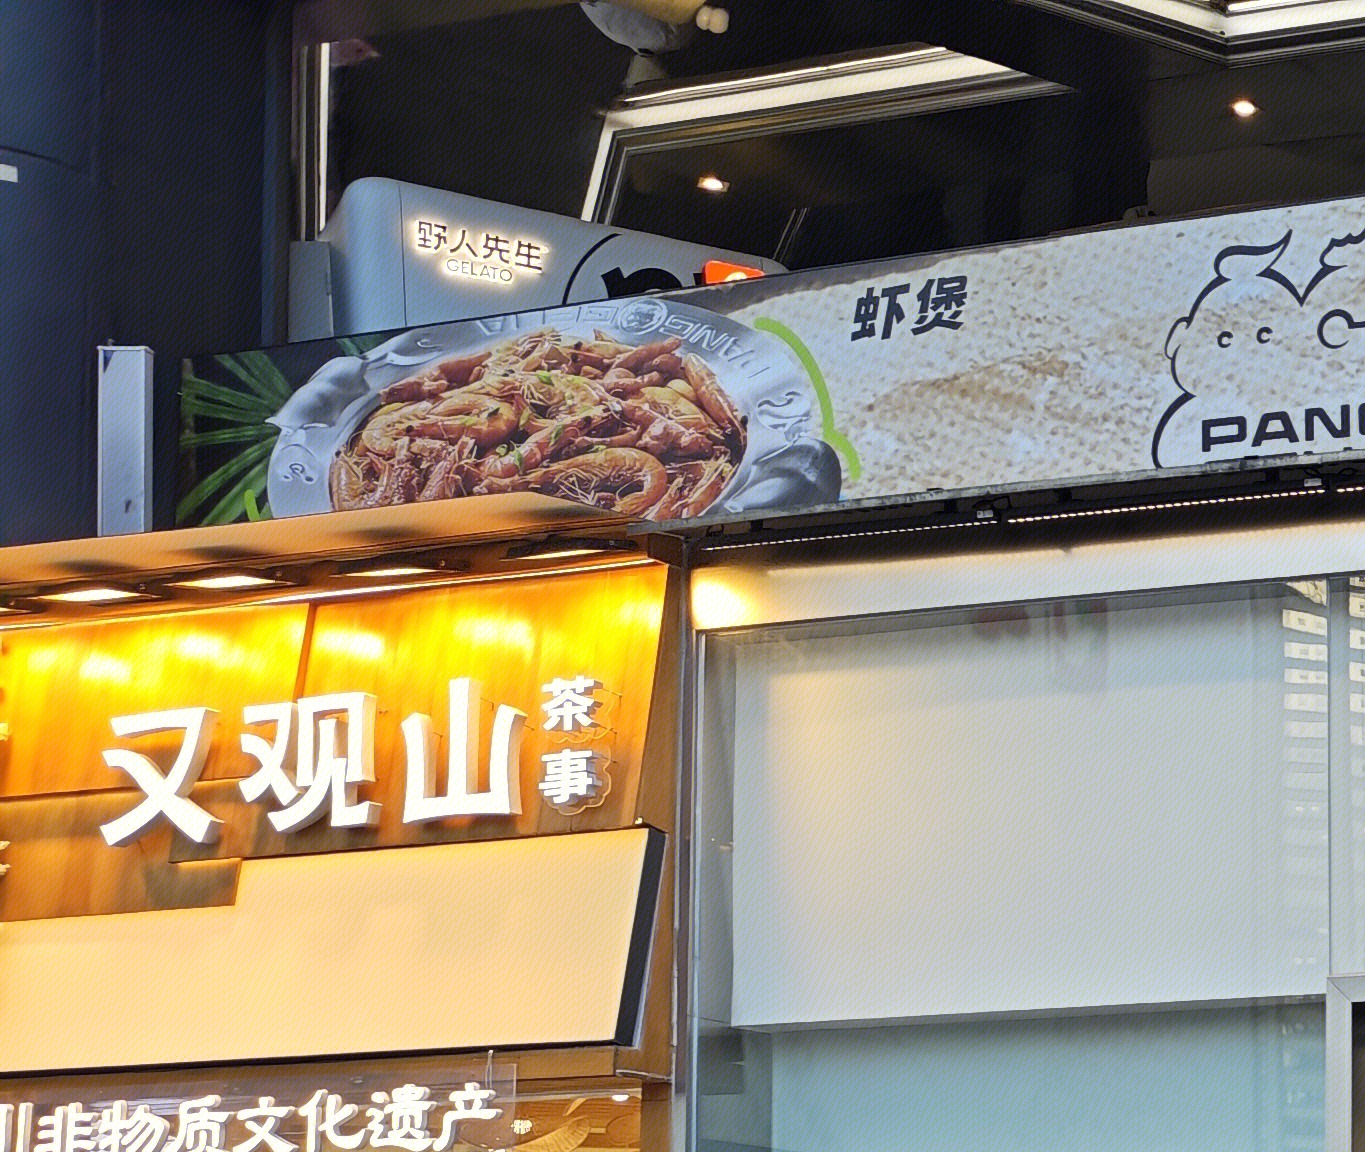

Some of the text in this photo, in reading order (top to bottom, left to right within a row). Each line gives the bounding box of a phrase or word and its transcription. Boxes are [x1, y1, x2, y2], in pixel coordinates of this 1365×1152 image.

[416, 220, 544, 273] 野人先生
[446, 259, 514, 283] GELATO
[851, 275, 968, 342] 虾煲
[100, 677, 527, 847] 又观山
[538, 676, 604, 806] 茶事
